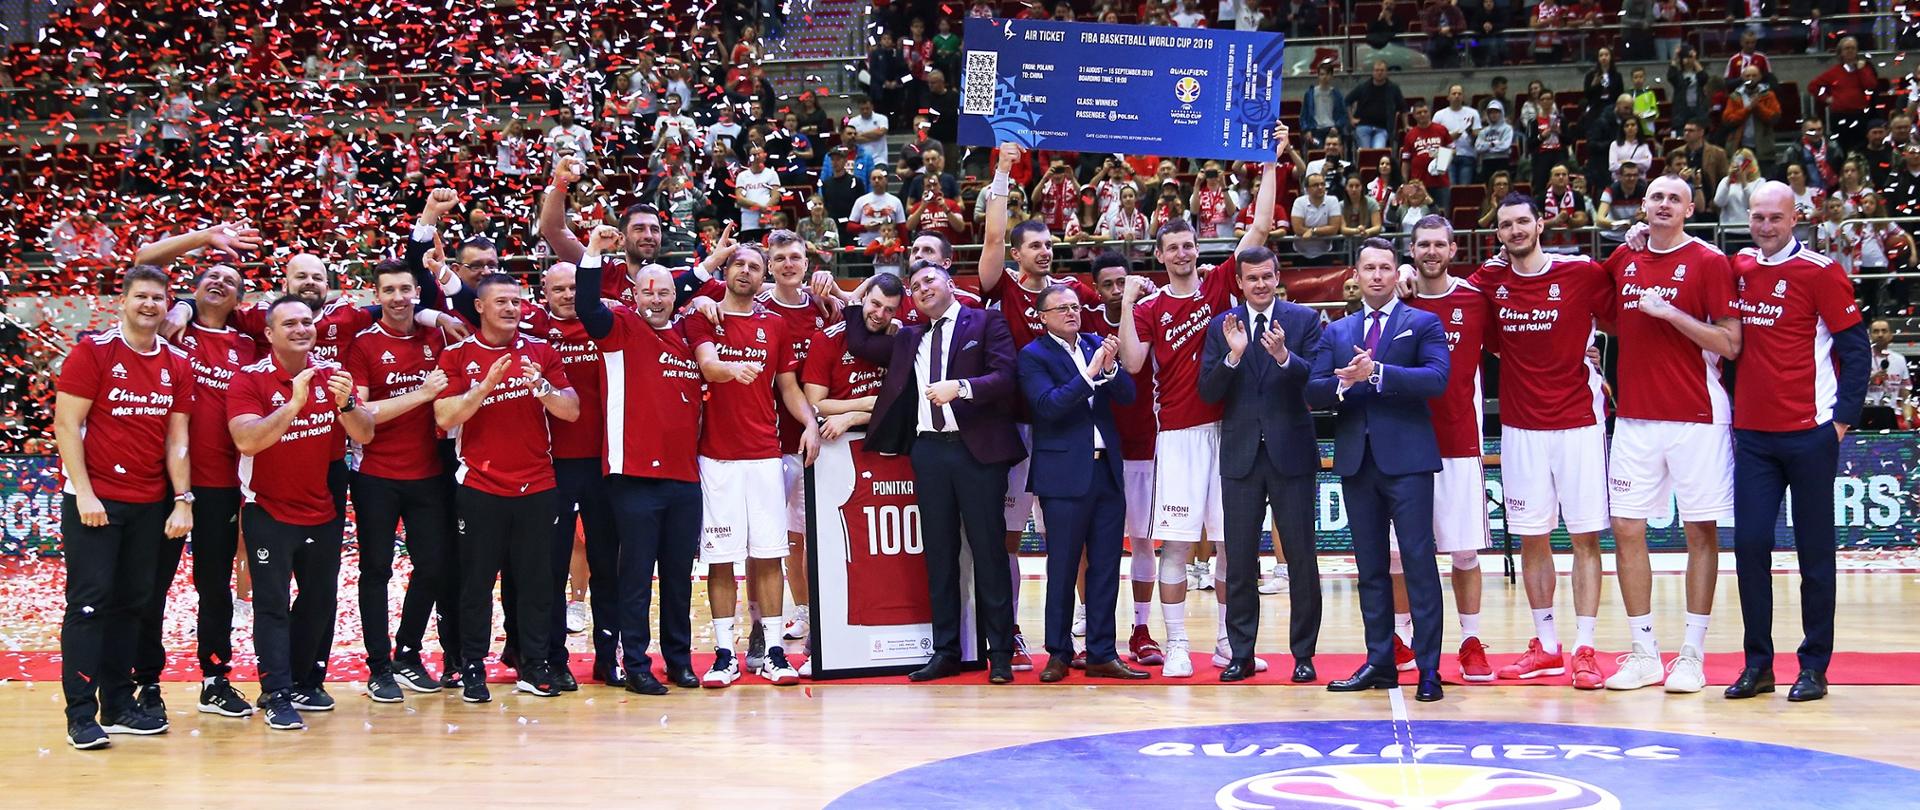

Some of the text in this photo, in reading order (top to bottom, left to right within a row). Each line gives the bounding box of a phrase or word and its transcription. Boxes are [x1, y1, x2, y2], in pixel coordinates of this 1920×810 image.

[1024, 30, 1065, 42] AIR TICKET
[1081, 32, 1214, 49] FIBA BASKETBALL WORLD CUP 2019
[1036, 64, 1054, 72] POLAND
[1086, 66, 1103, 74] AUGUST
[1115, 68, 1141, 76] SEPTEMBER
[1141, 69, 1154, 77] 2019
[1170, 68, 1208, 76] QUALIFIERS
[1095, 98, 1118, 106] WINNERS
[1076, 110, 1106, 119] PASSENGER:
[921, 211, 948, 220] POLAN
[1499, 307, 1558, 322] China 2019
[1757, 302, 1783, 318] 2019
[1165, 303, 1211, 342] China 2019
[1518, 324, 1525, 332] IN
[1526, 323, 1552, 331] POLAND
[1752, 317, 1775, 326] POLAND
[1172, 335, 1187, 351] MADE
[1191, 316, 1211, 333] POLAND
[716, 343, 767, 360] China 2019
[659, 352, 686, 368] China
[386, 372, 418, 384] China
[663, 370, 678, 378] MADE
[849, 371, 876, 384] China
[496, 394, 504, 402] IN
[505, 388, 529, 400] POLAND
[852, 384, 868, 395] MADE
[108, 387, 174, 408] China 2019
[112, 406, 168, 416] MADE IN POLAND
[310, 411, 335, 425] 2019
[281, 425, 332, 442] MADE IN POLAND
[873, 481, 914, 496] PONITKA
[1163, 505, 1189, 513] VERONI
[705, 526, 732, 534] VERONI
[863, 505, 924, 556] 100
[1138, 743, 1682, 761] QUALIFIERS
